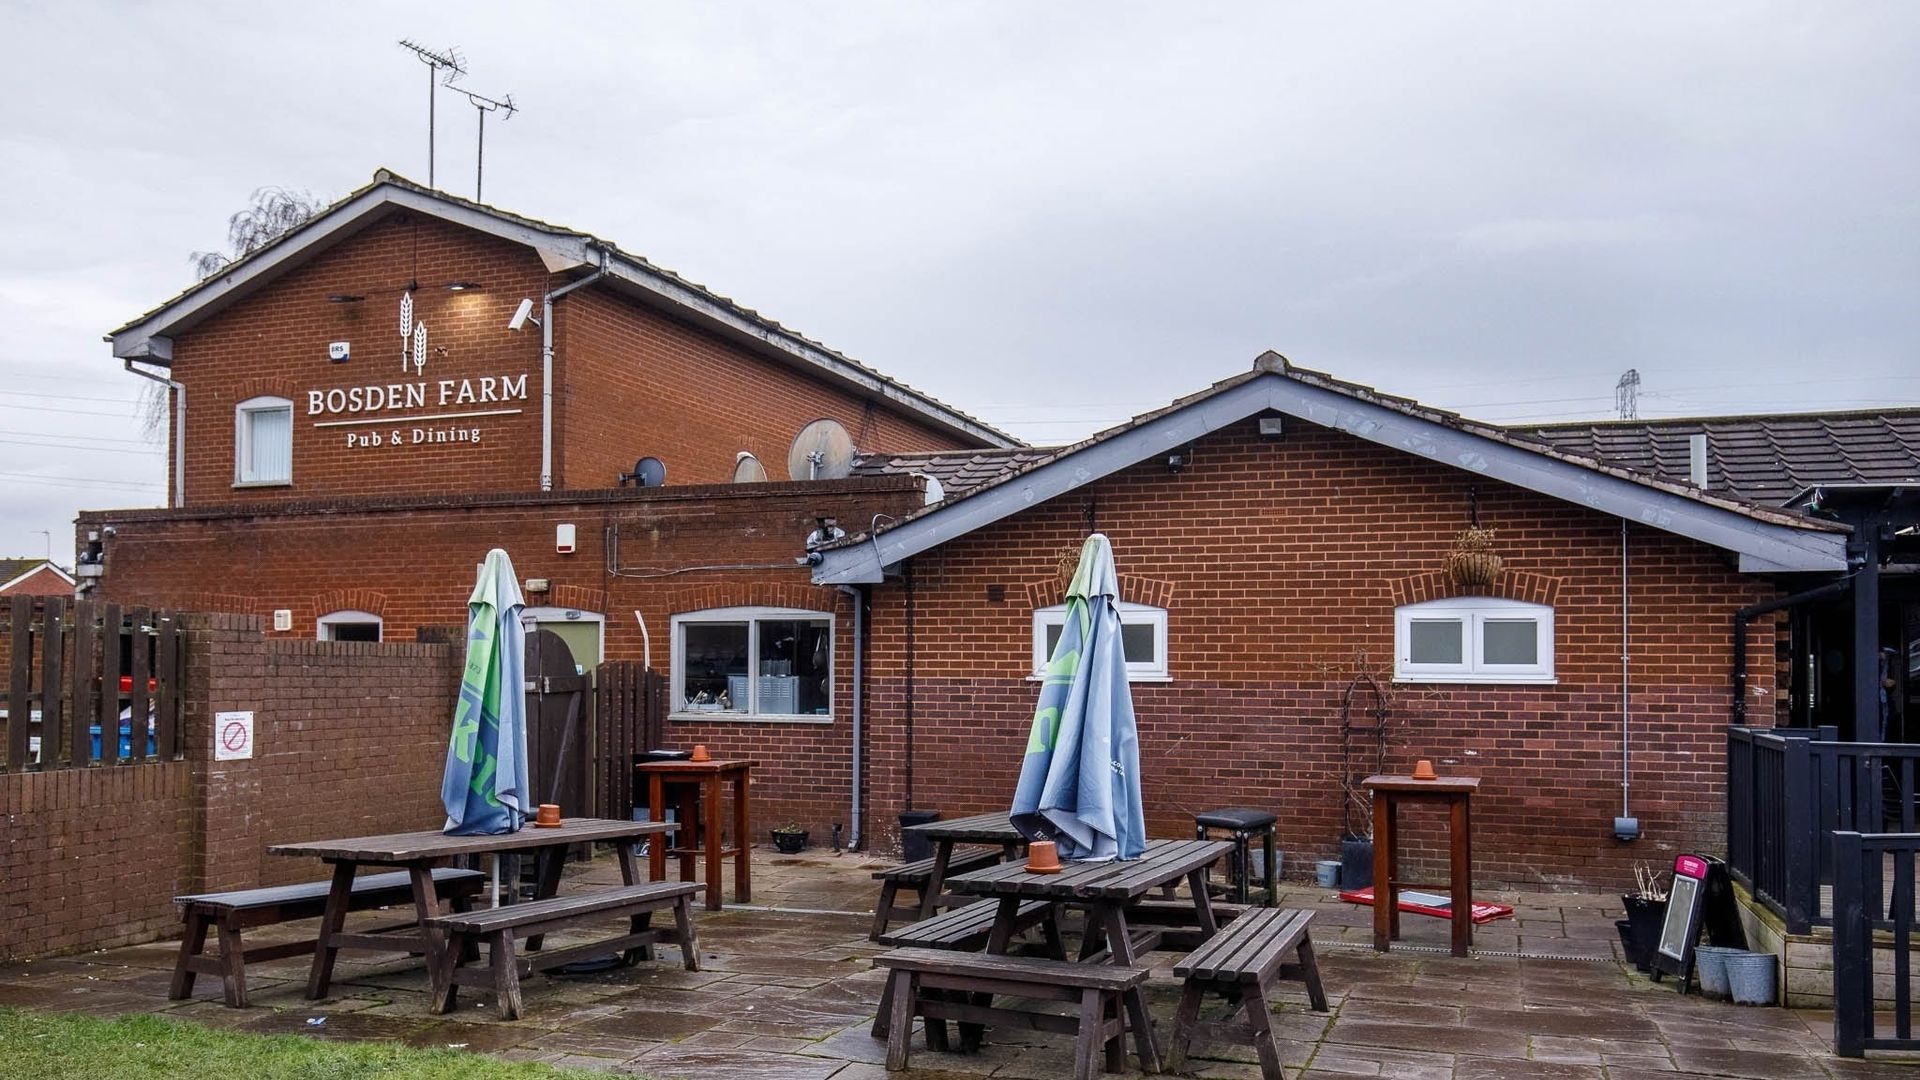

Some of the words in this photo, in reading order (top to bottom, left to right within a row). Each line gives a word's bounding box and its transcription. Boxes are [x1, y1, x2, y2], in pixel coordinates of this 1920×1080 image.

[308, 382, 427, 415] BOSDEN
[438, 374, 528, 406] FARM
[347, 431, 382, 448] Pub
[391, 430, 403, 446] &
[412, 426, 481, 443] Dining
